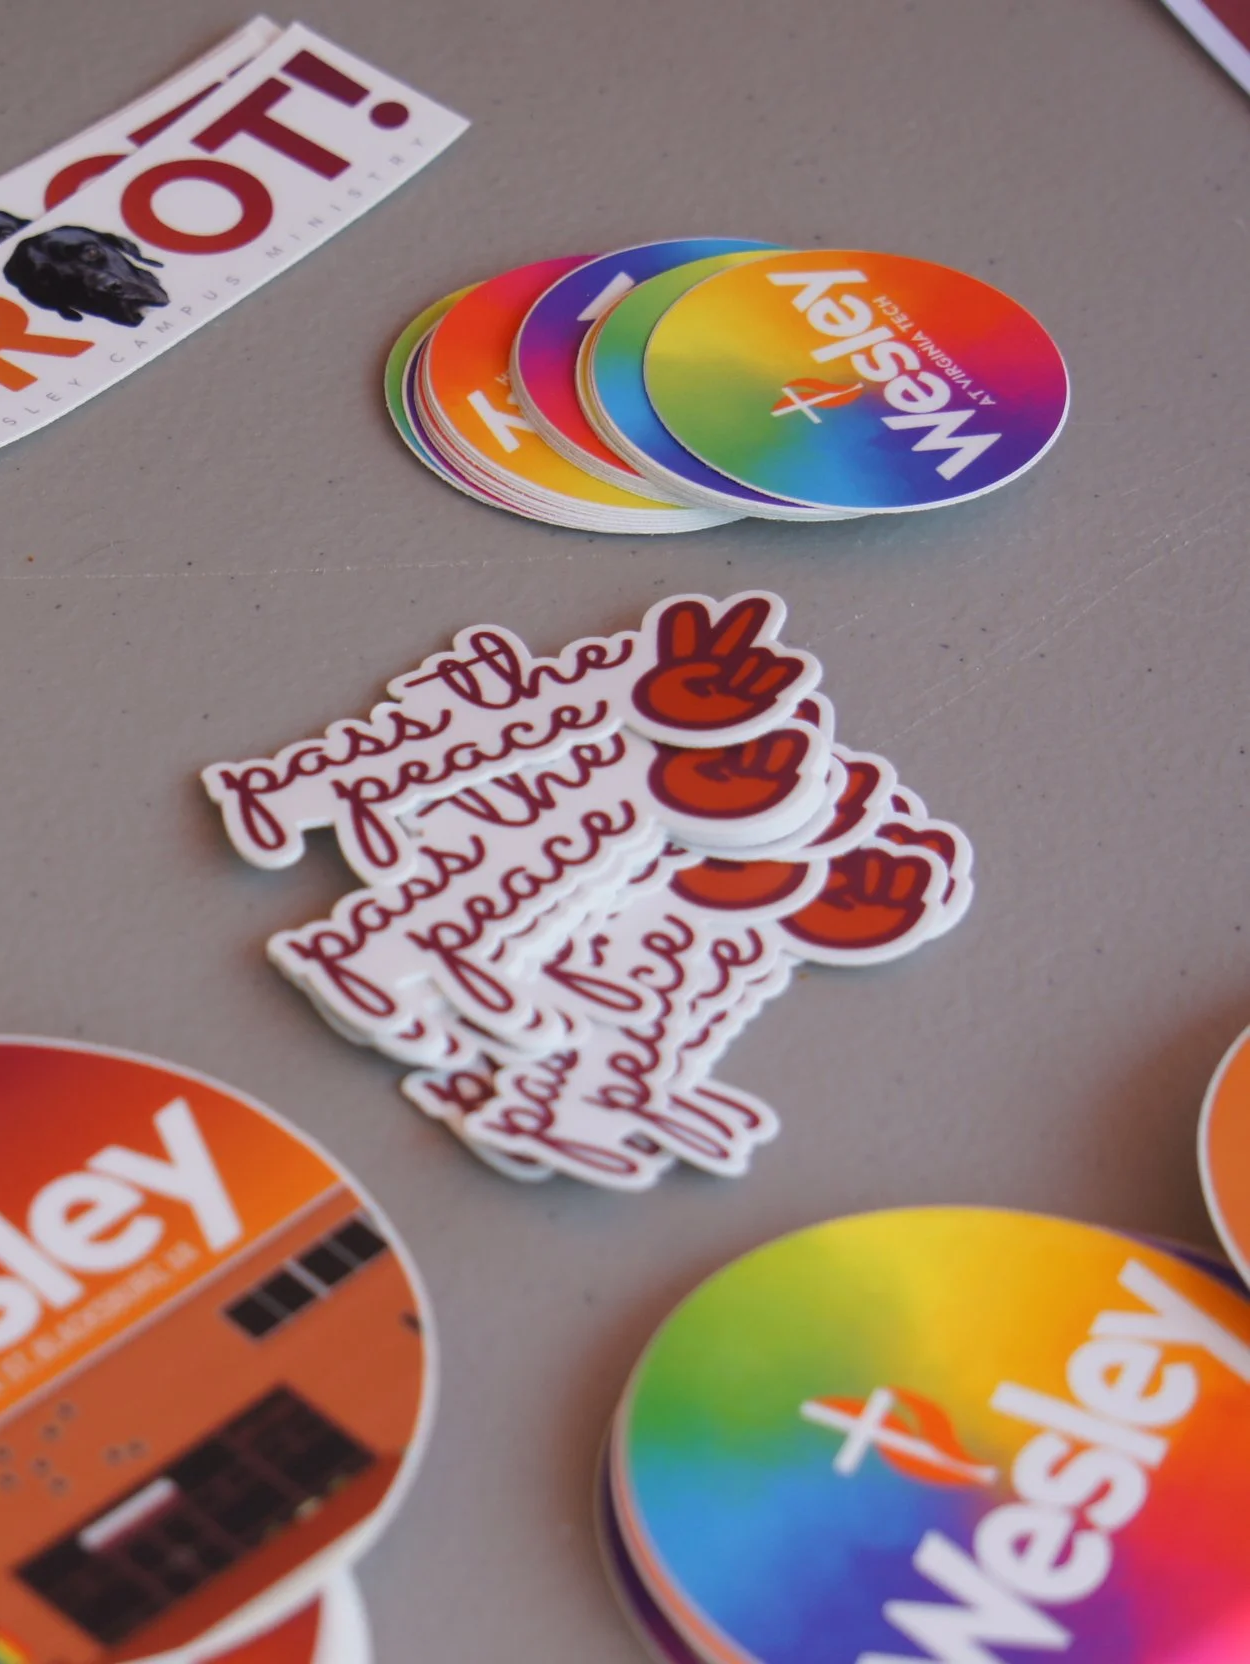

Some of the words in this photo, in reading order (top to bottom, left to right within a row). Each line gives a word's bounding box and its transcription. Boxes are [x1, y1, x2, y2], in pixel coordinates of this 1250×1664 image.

[109, 275, 241, 364] CAMPUS
[265, 137, 425, 259] MINISTRY
[872, 295, 915, 332] TECH
[766, 270, 1002, 481] Wesley
[910, 329, 974, 391] VIRGINIA
[968, 390, 997, 406] AT
[220, 709, 452, 849] pass
[405, 631, 634, 708] the
[334, 699, 608, 867] peace
[291, 836, 485, 1016] pass
[408, 800, 636, 1014] peace
